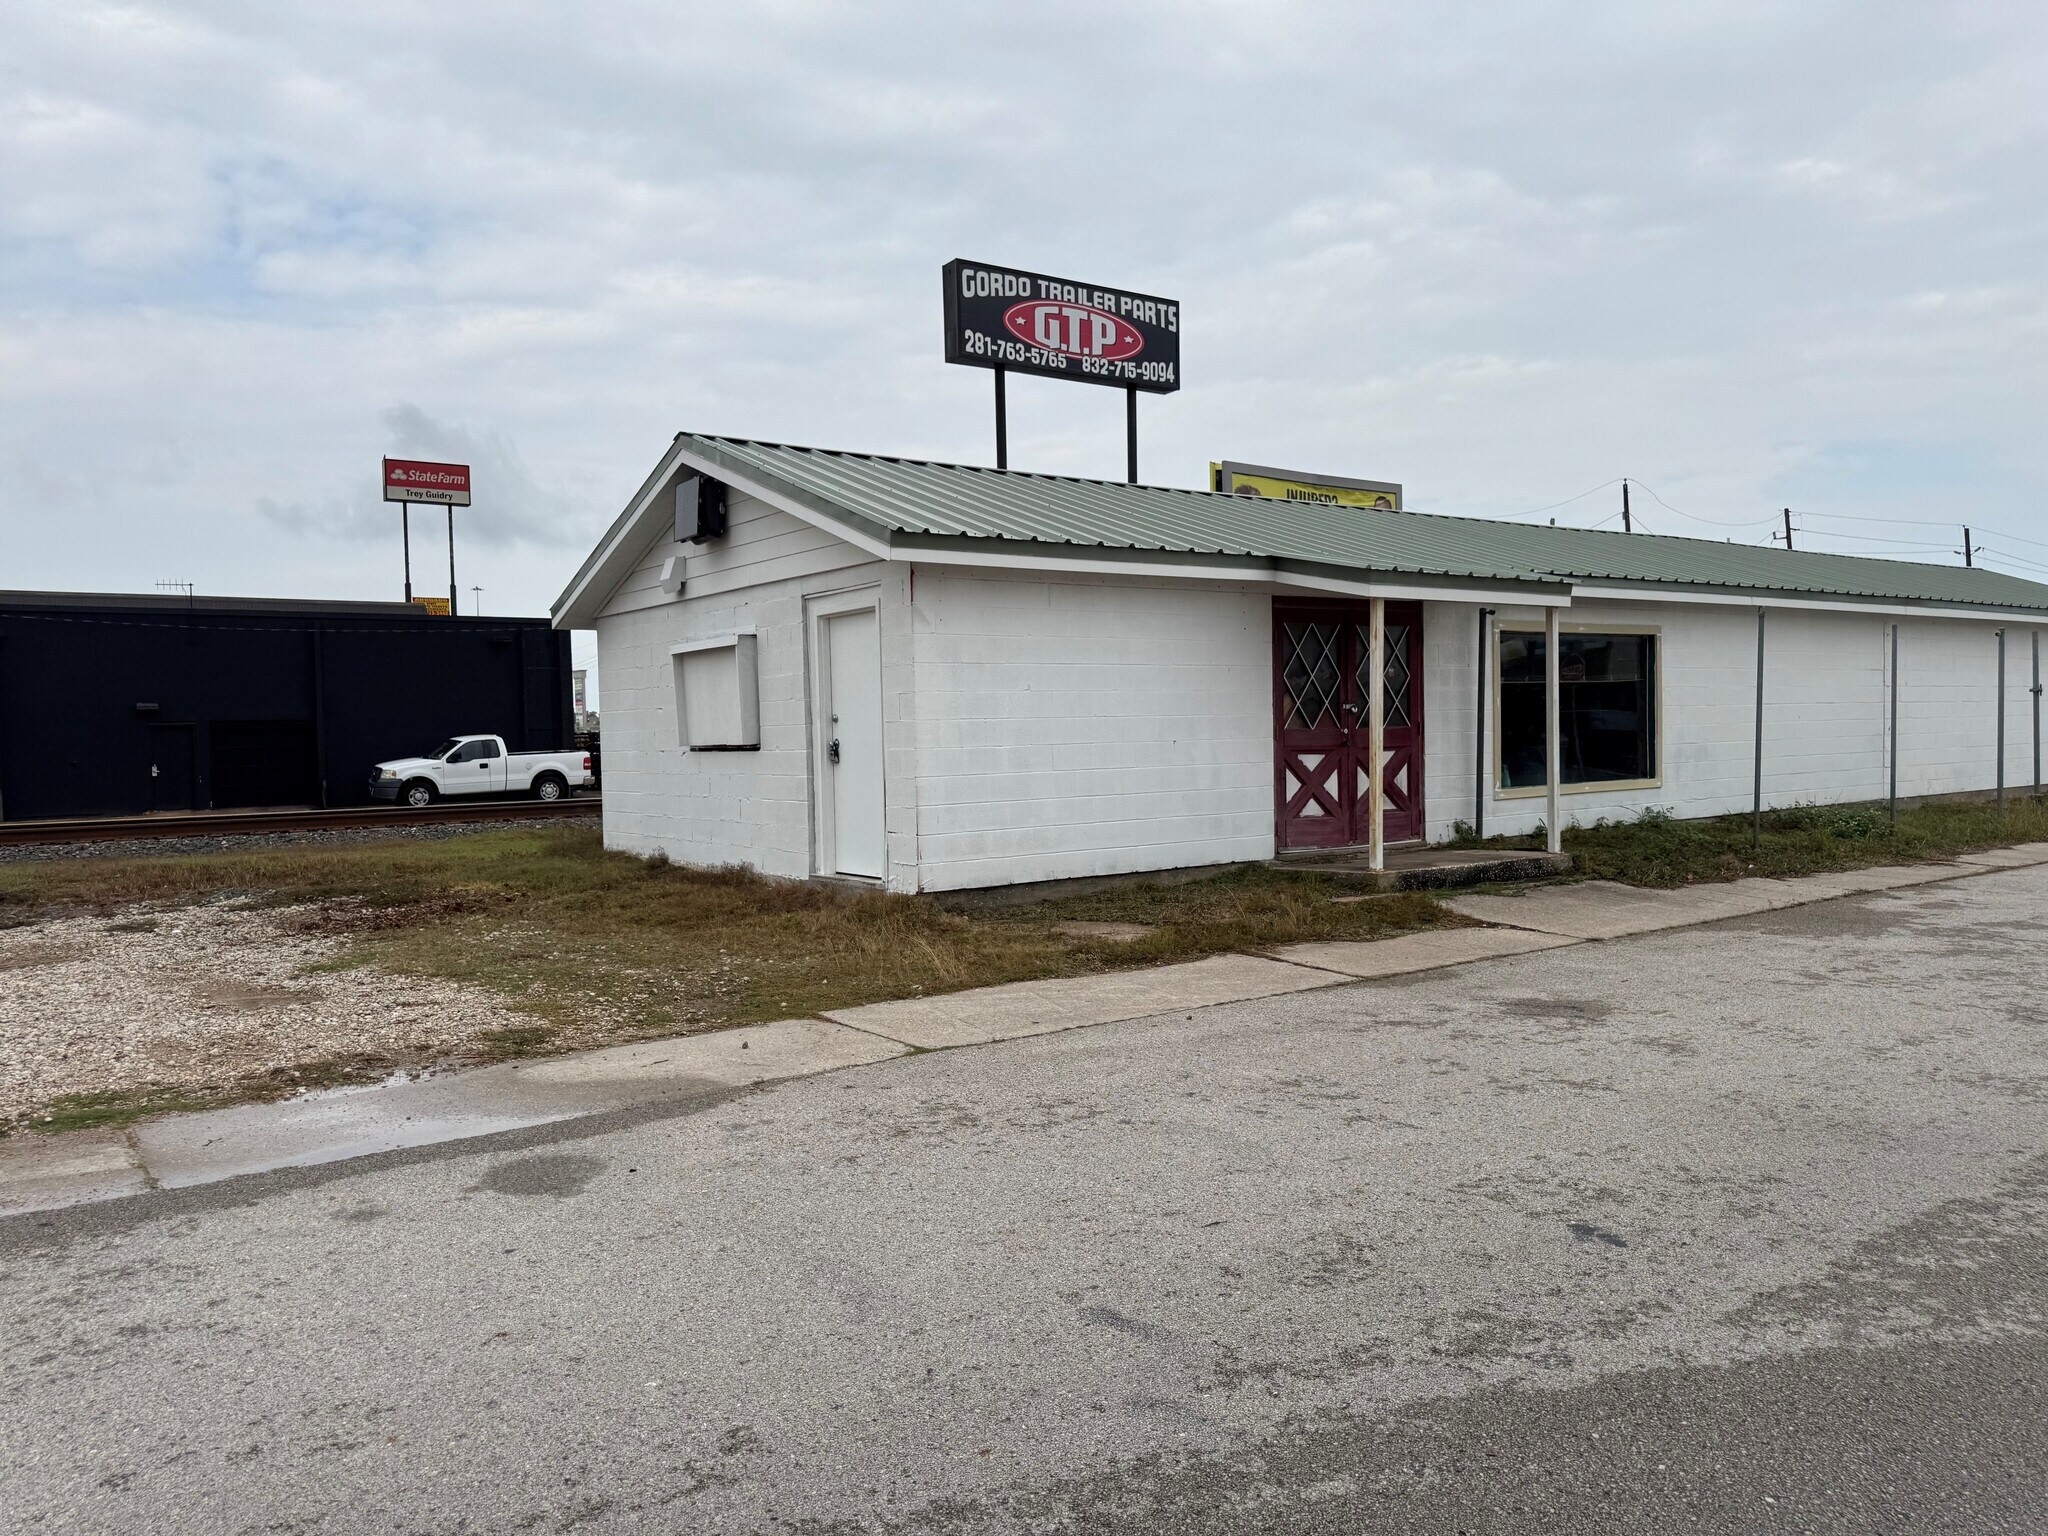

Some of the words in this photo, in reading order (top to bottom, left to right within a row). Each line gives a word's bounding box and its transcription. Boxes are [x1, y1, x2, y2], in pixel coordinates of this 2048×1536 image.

[962, 269, 1031, 298] GORDO
[1037, 279, 1117, 313] TRAILER
[1120, 296, 1177, 333] PARTS
[965, 329, 1067, 369] 281-763-5765
[1082, 356, 1175, 383] 832-715-9094
[1034, 306, 1117, 355] G.T.P
[405, 488, 423, 499] Trey
[425, 490, 453, 501] Guidry
